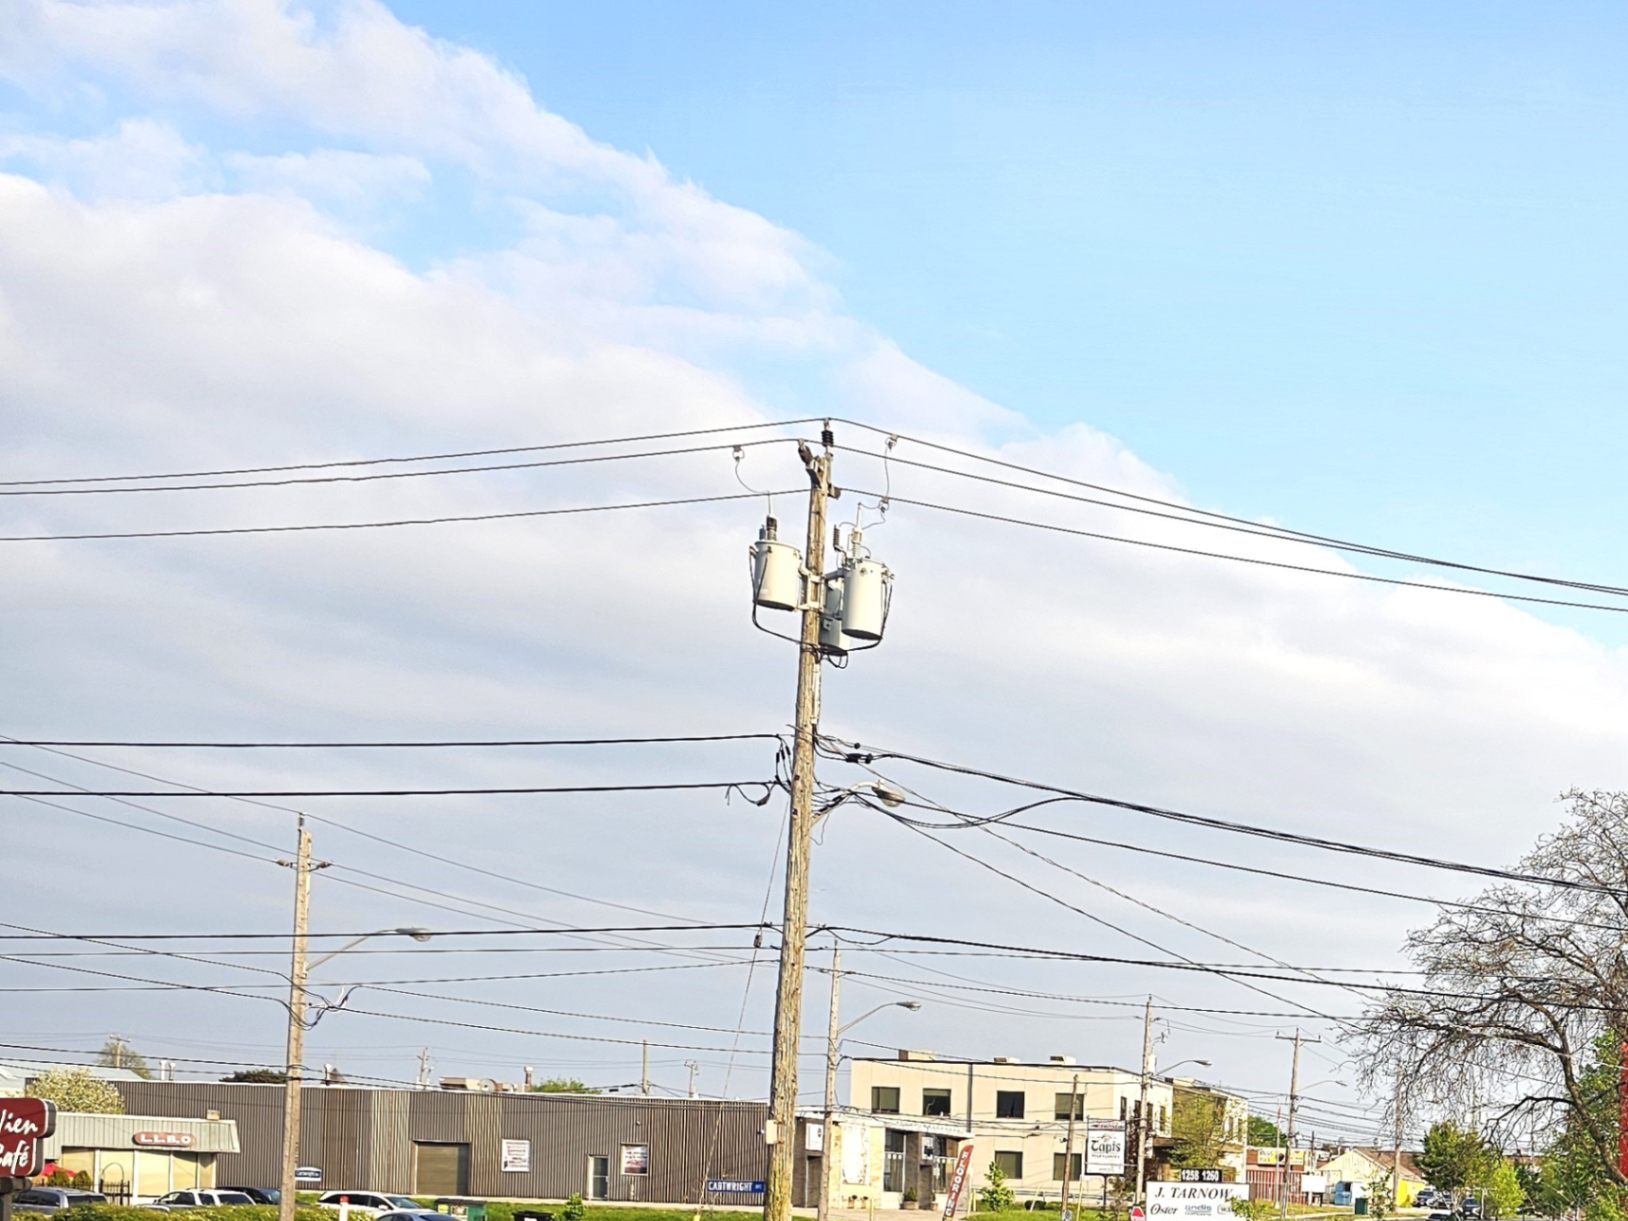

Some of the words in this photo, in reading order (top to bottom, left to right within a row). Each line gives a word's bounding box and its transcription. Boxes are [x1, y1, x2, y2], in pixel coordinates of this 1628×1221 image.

[708, 1181, 753, 1191] CARTWRIGHT
[945, 1151, 969, 1217] FLOORING
[1155, 1187, 1164, 1198] J.
[1171, 1187, 1233, 1199] TARNOW
